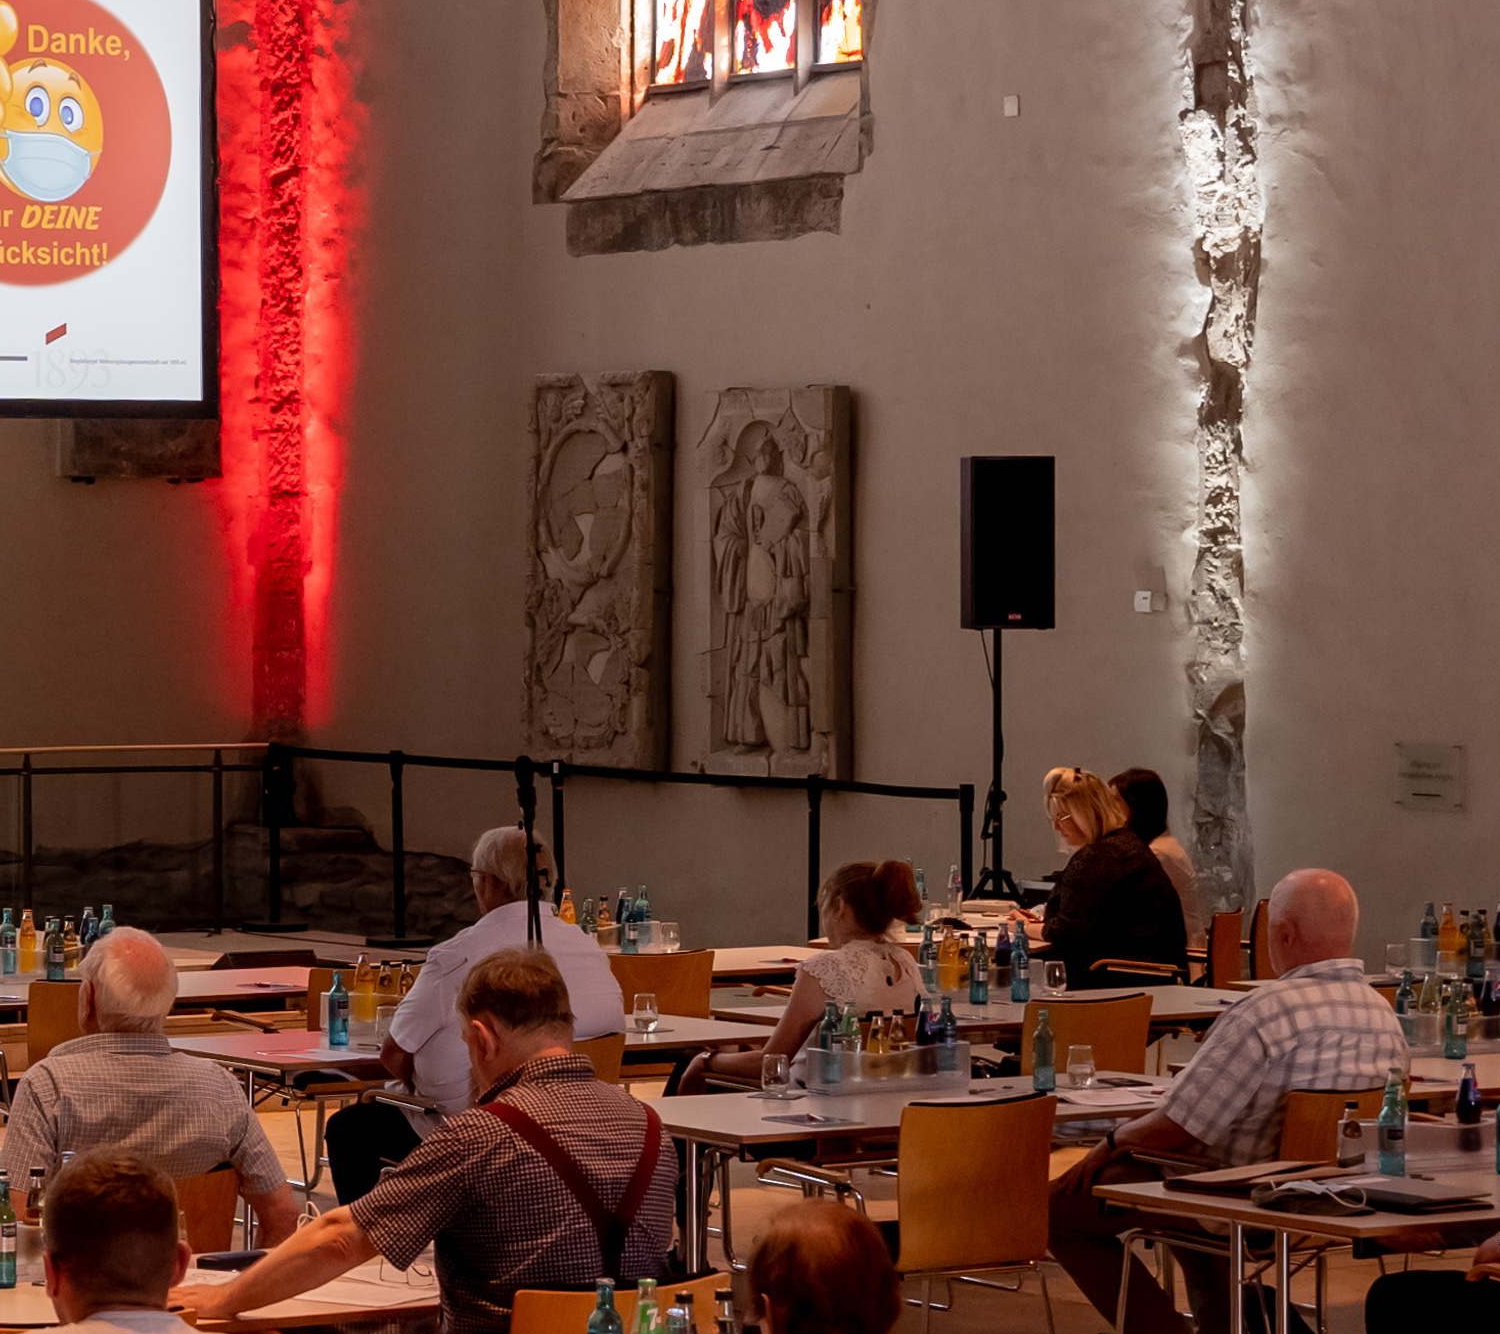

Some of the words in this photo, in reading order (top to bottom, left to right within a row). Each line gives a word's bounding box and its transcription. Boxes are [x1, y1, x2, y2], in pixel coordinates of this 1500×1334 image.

[28, 24, 130, 62] Danke,
[20, 204, 103, 230] DEINE
[30, 348, 111, 395] 1893
